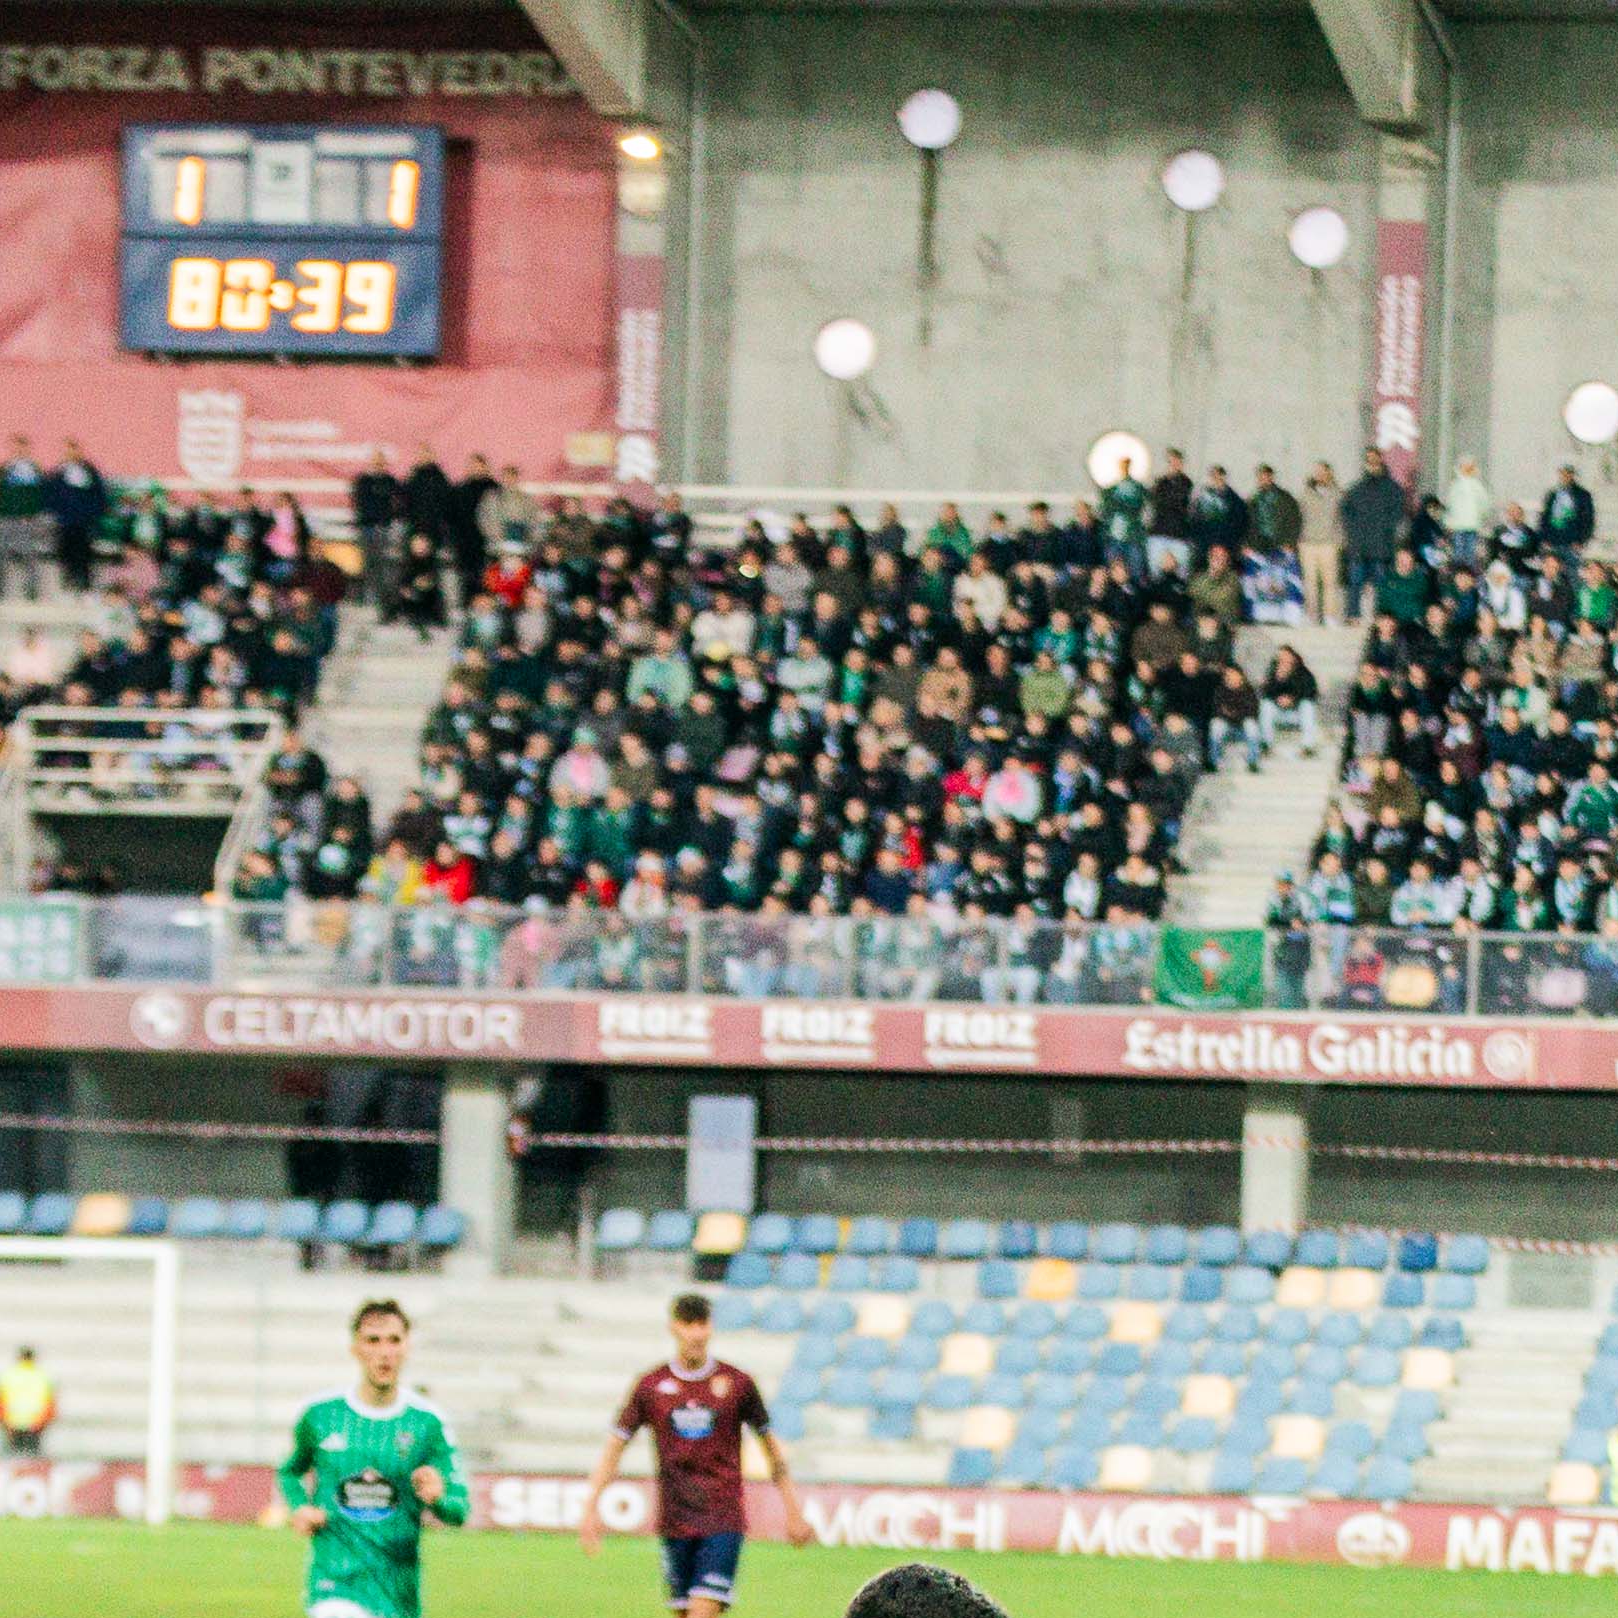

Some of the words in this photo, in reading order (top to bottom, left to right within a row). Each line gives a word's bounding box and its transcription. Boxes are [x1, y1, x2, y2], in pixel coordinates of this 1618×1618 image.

[174, 156, 206, 227] 1
[387, 159, 420, 230] 1
[167, 257, 397, 335] 80:39
[203, 996, 523, 1051] CELTAMOTOR
[598, 1003, 712, 1039] FROIZ
[762, 1006, 874, 1044] FROIZ
[924, 1010, 1036, 1049] FROIZ
[1124, 1020, 1302, 1072] Estrella
[1308, 1024, 1476, 1077] Galicia
